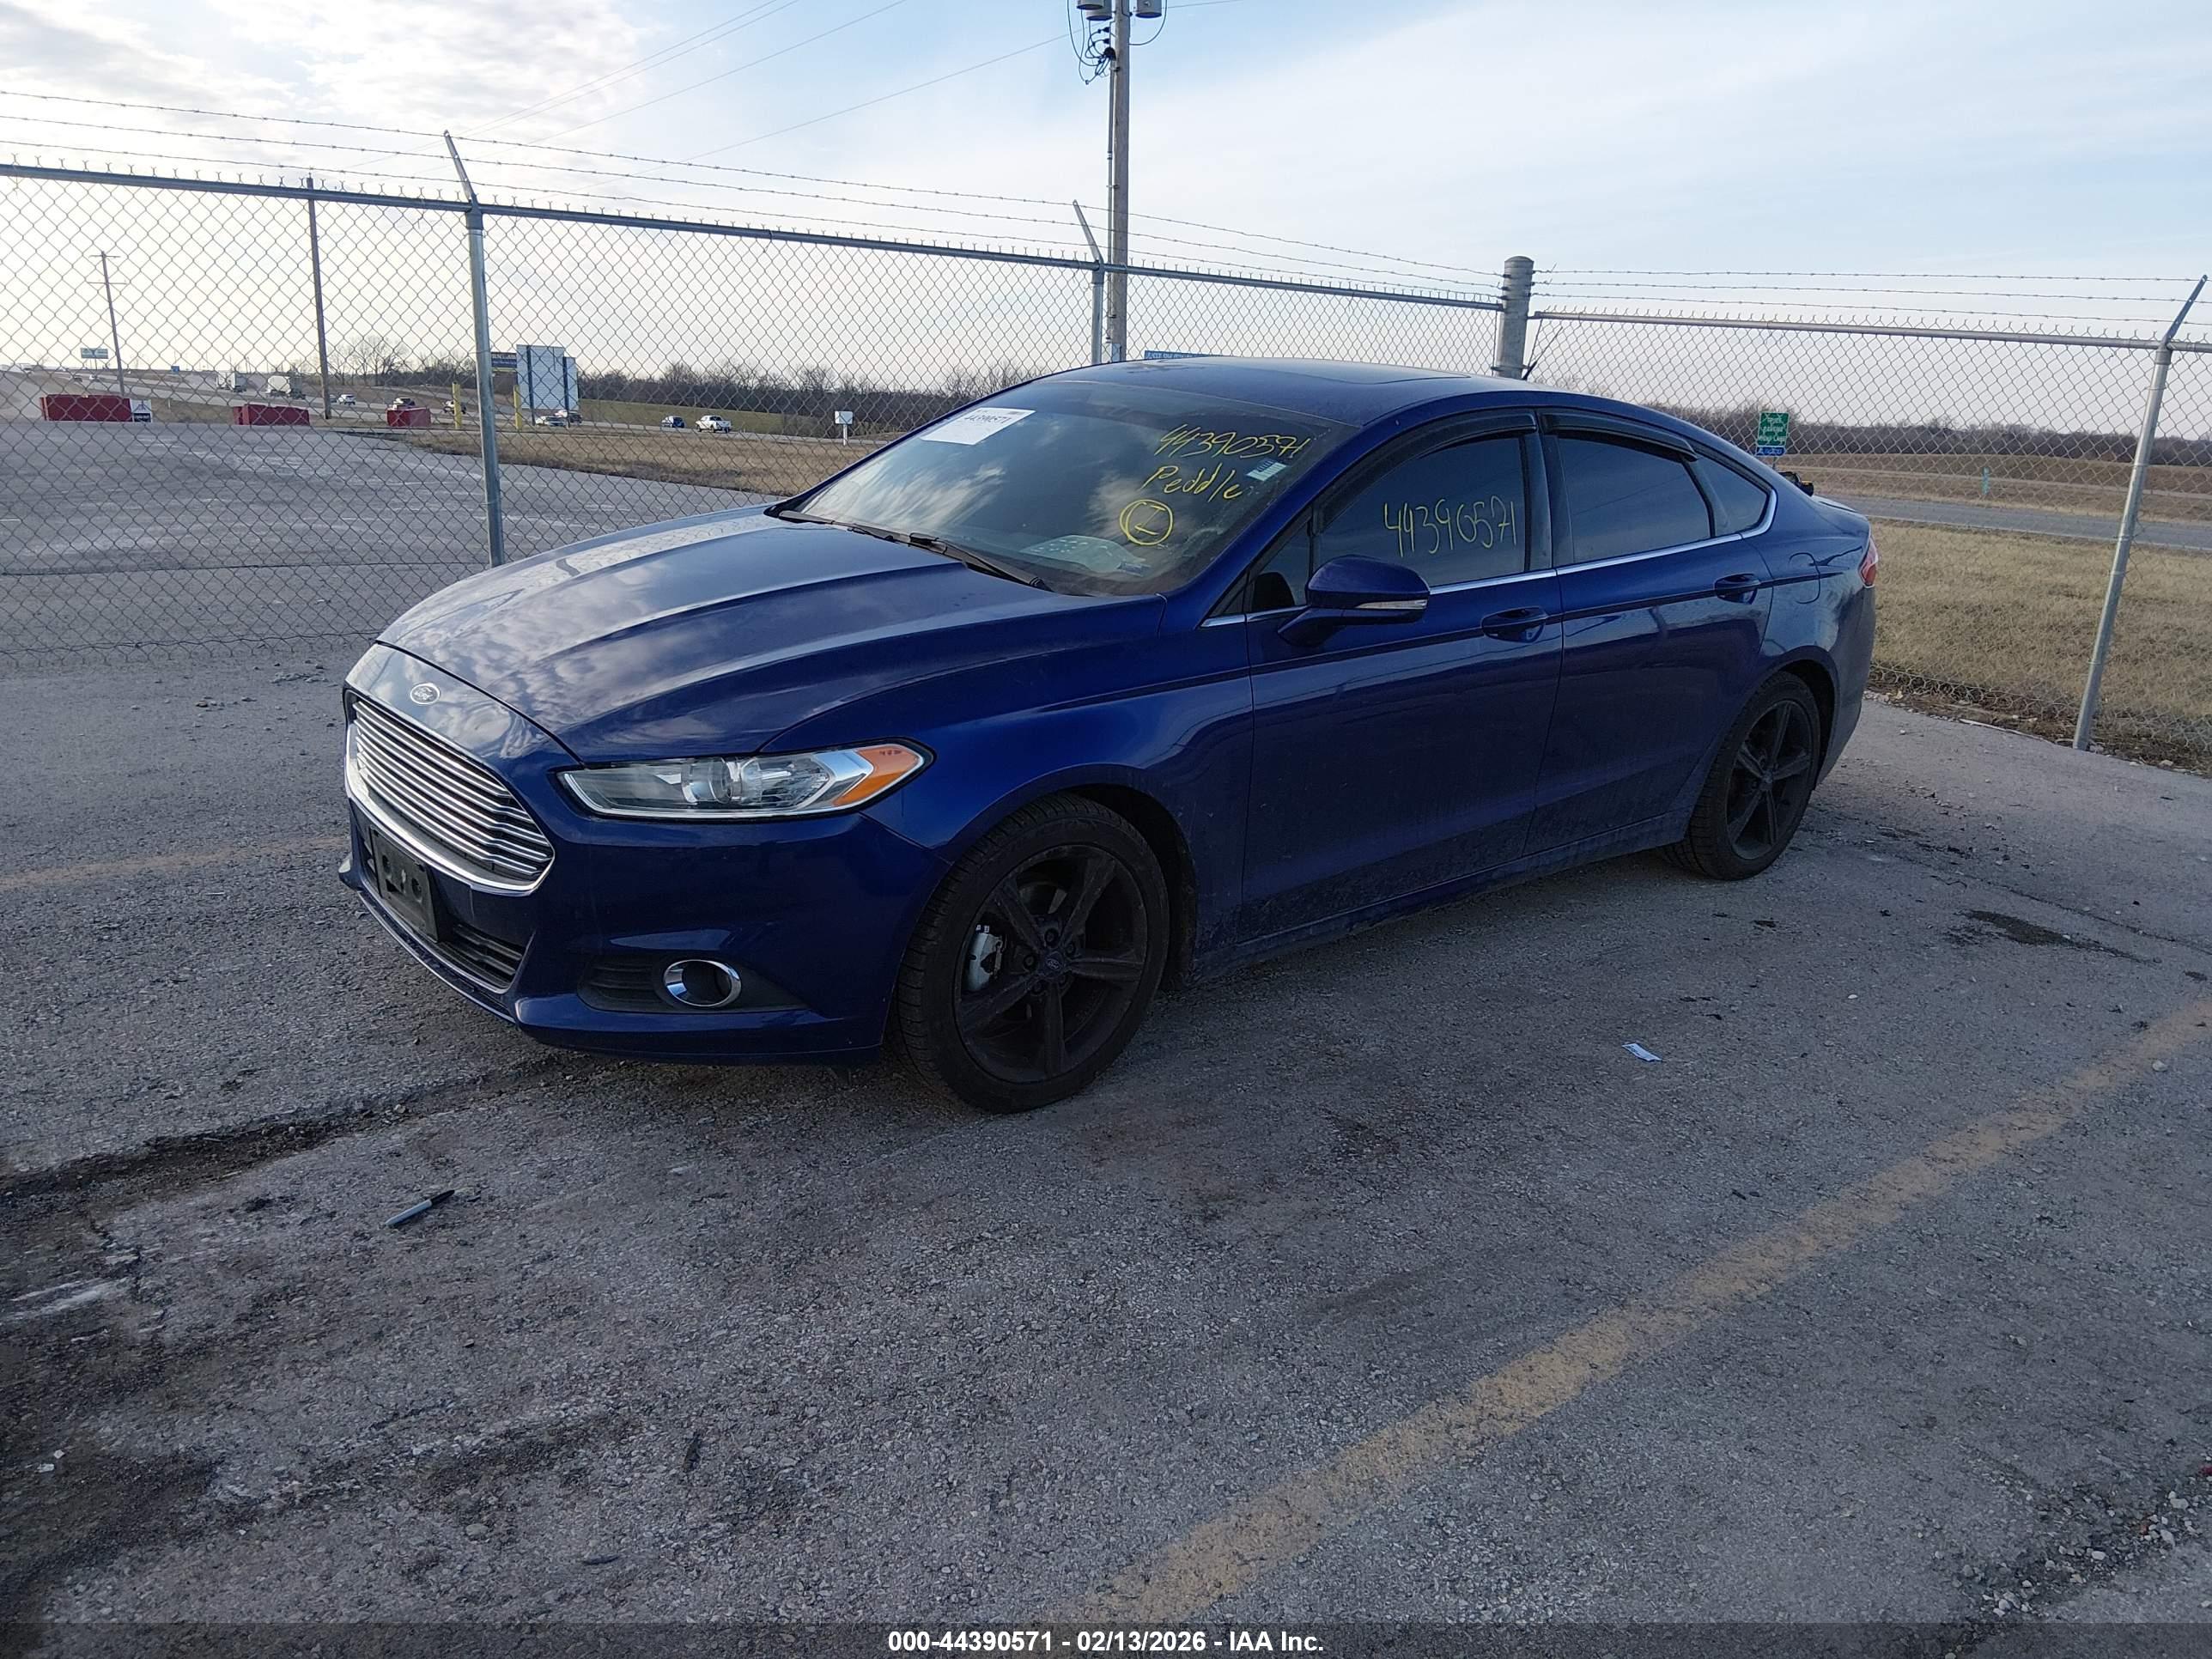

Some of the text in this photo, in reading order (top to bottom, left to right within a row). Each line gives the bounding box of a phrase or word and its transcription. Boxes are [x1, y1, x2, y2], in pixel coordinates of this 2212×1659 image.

[1154, 423, 1311, 459] 44390571
[1138, 462, 1243, 503] Peddle
[1383, 495, 1517, 558] 44390571
